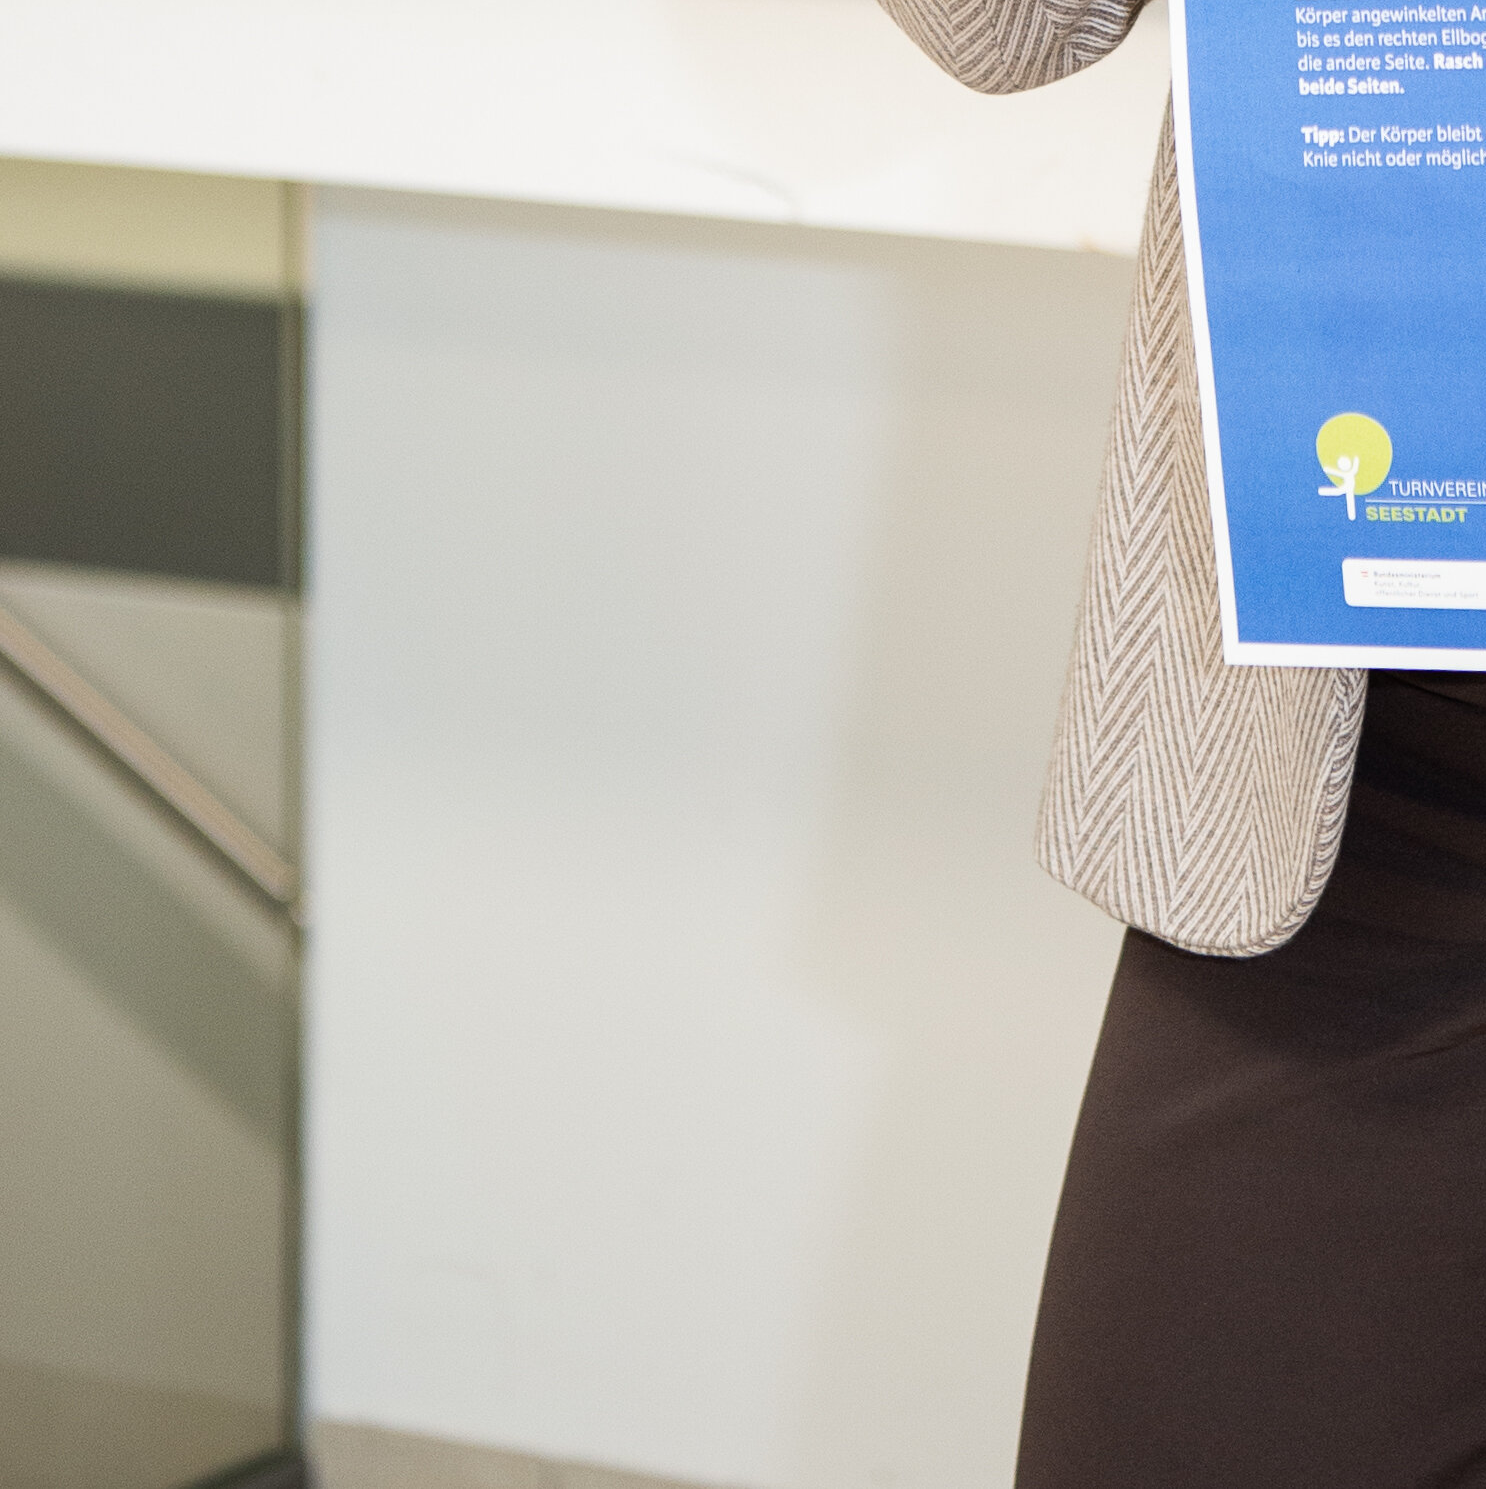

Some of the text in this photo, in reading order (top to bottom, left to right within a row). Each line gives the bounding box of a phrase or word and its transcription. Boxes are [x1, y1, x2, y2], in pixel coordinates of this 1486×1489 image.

[1295, 6, 1349, 27] Körper
[1351, 4, 1467, 27] angewinkelten
[1296, 30, 1320, 48] bis
[1322, 33, 1341, 48] es
[1343, 29, 1374, 47] den
[1377, 28, 1438, 47] rechten
[1297, 53, 1323, 72] die
[1325, 53, 1381, 71] andere
[1384, 53, 1430, 71] Seite.
[1433, 51, 1484, 70] Rasch
[1298, 76, 1405, 95] beide Seiten.
[1300, 124, 1345, 148] Tipp:
[1348, 126, 1377, 144] Der
[1380, 125, 1433, 146] Körper
[1436, 124, 1483, 142] bleibt
[1303, 149, 1338, 168] Knie
[1341, 148, 1383, 167] nicht
[1385, 148, 1423, 167] oder
[1365, 506, 1468, 523] SEESTADT
